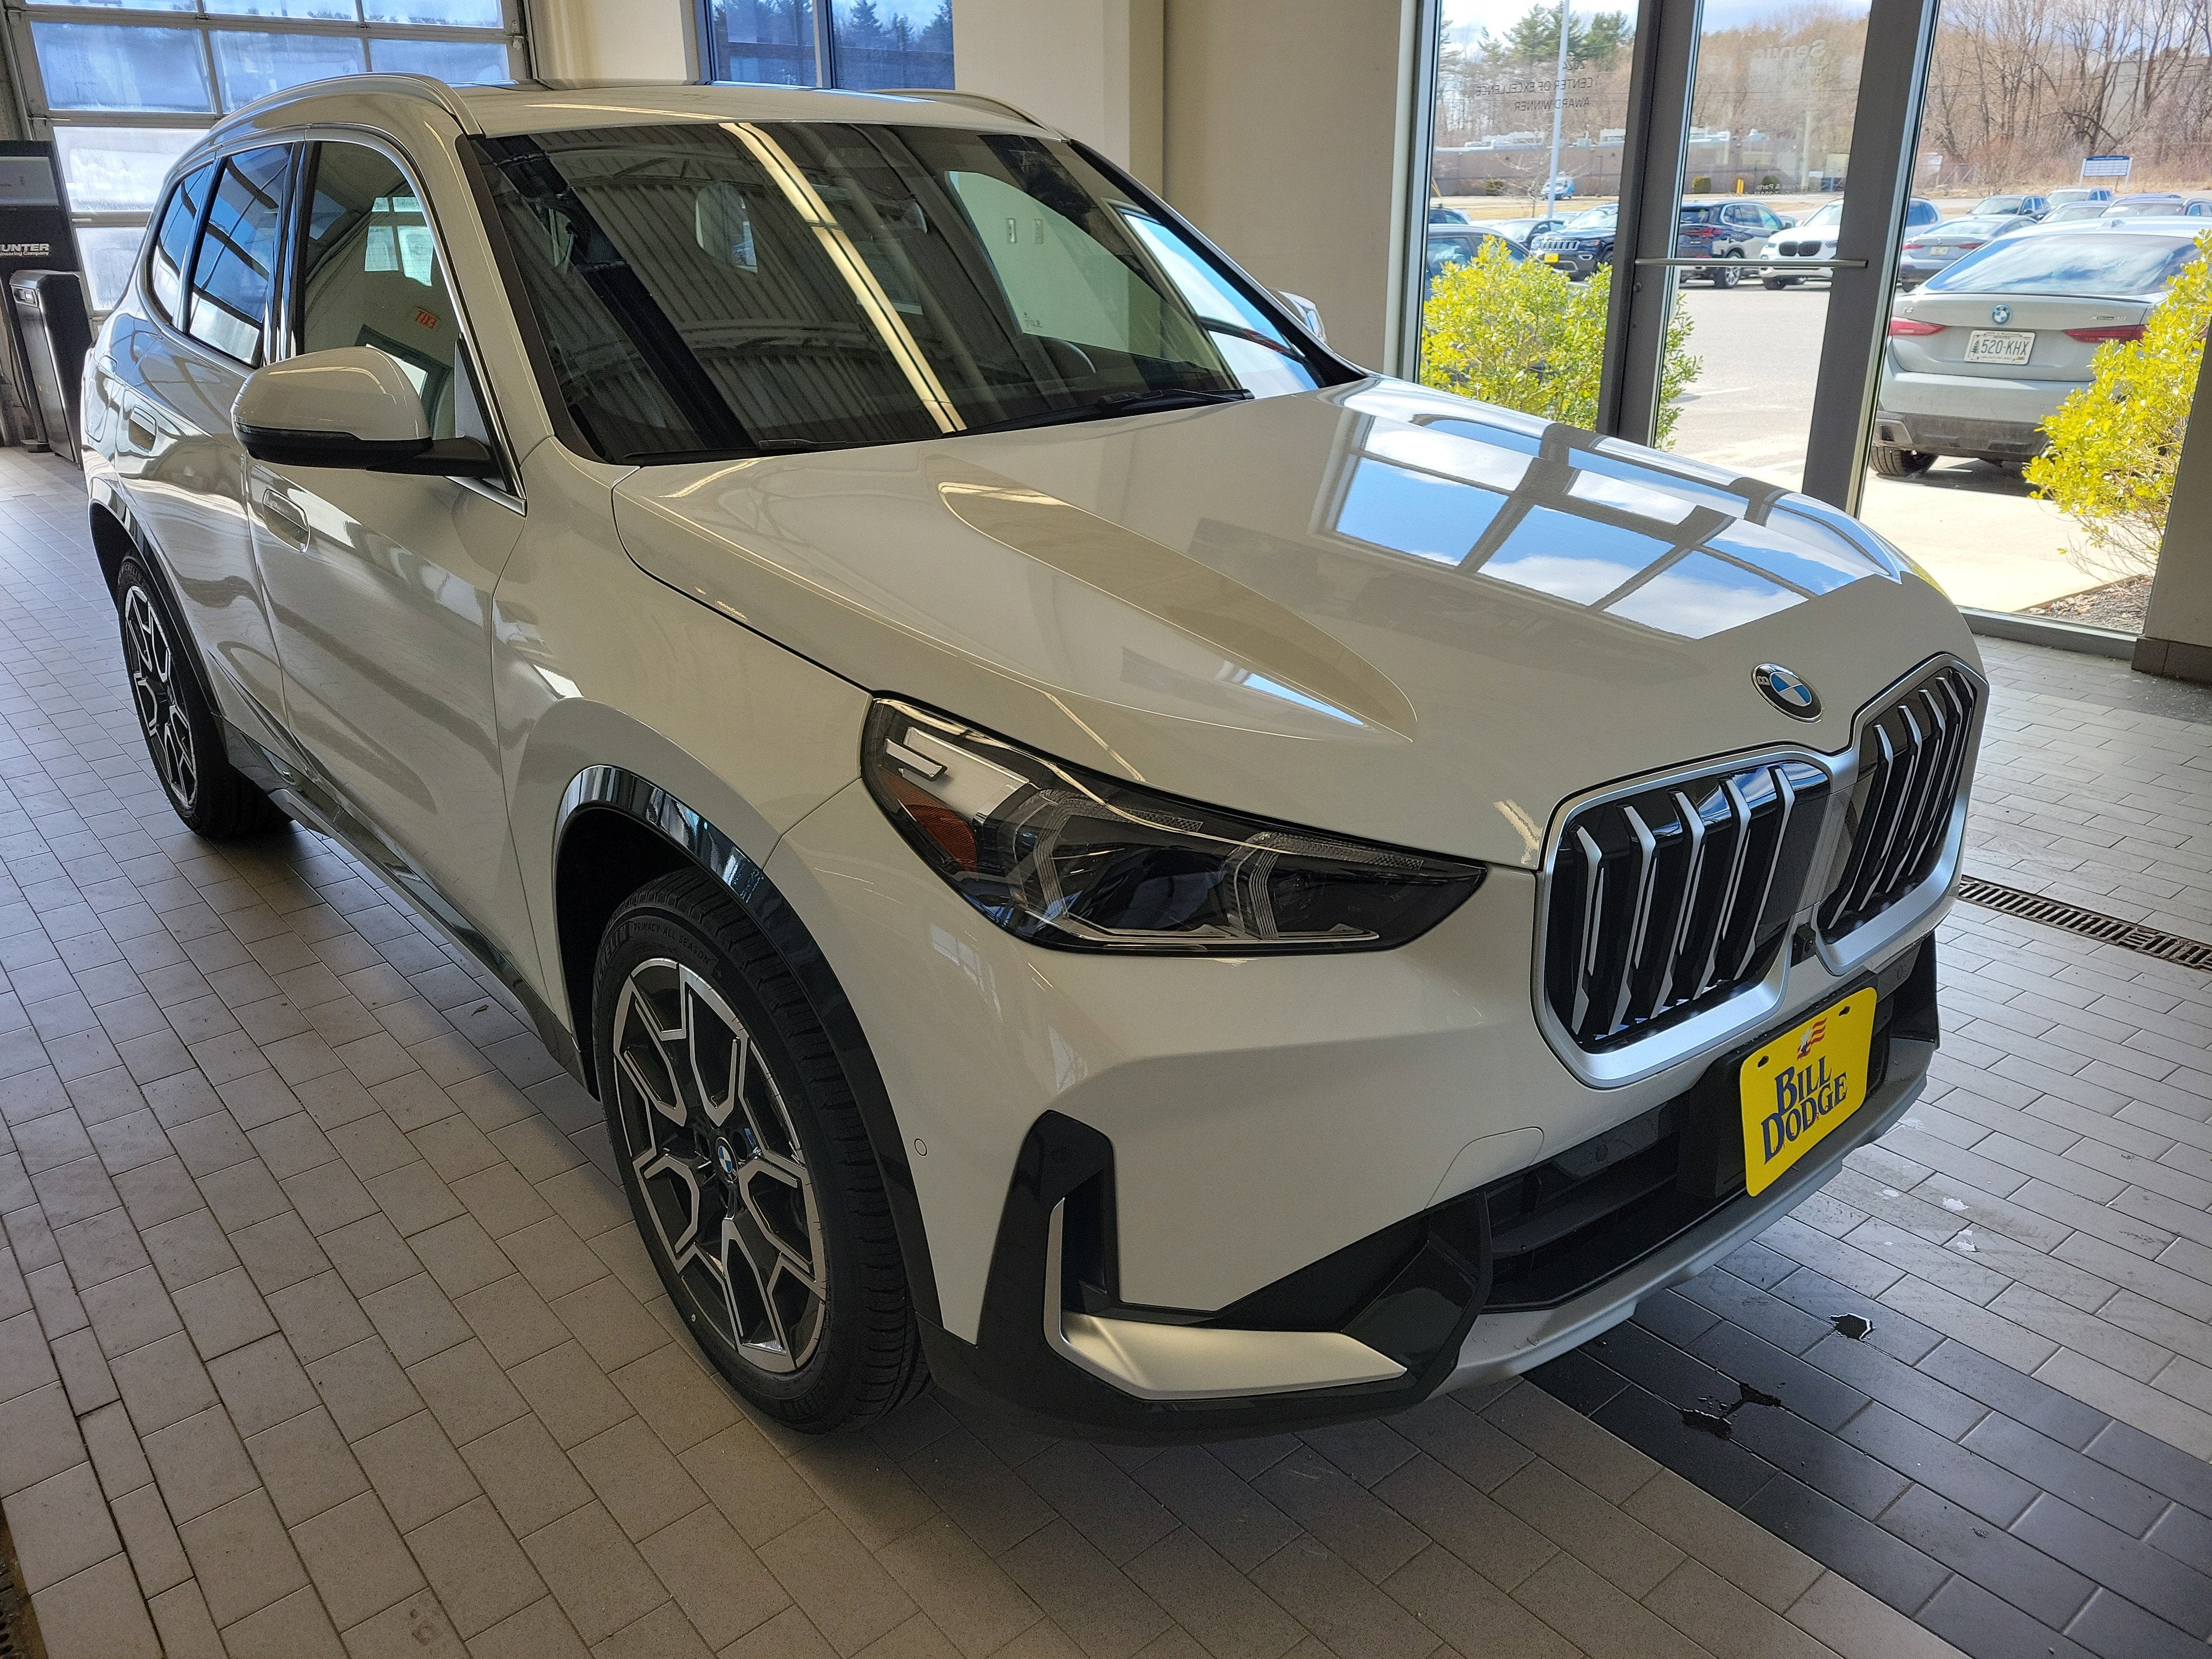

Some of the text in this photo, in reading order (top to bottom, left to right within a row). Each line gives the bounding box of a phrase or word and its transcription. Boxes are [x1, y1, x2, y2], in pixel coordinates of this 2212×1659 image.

[0, 244, 49, 252] UNTER
[634, 922, 710, 966] PRIMACY ALL SEASON
[1774, 1055, 1833, 1115] BILL
[1761, 1072, 1848, 1165] DODGE
